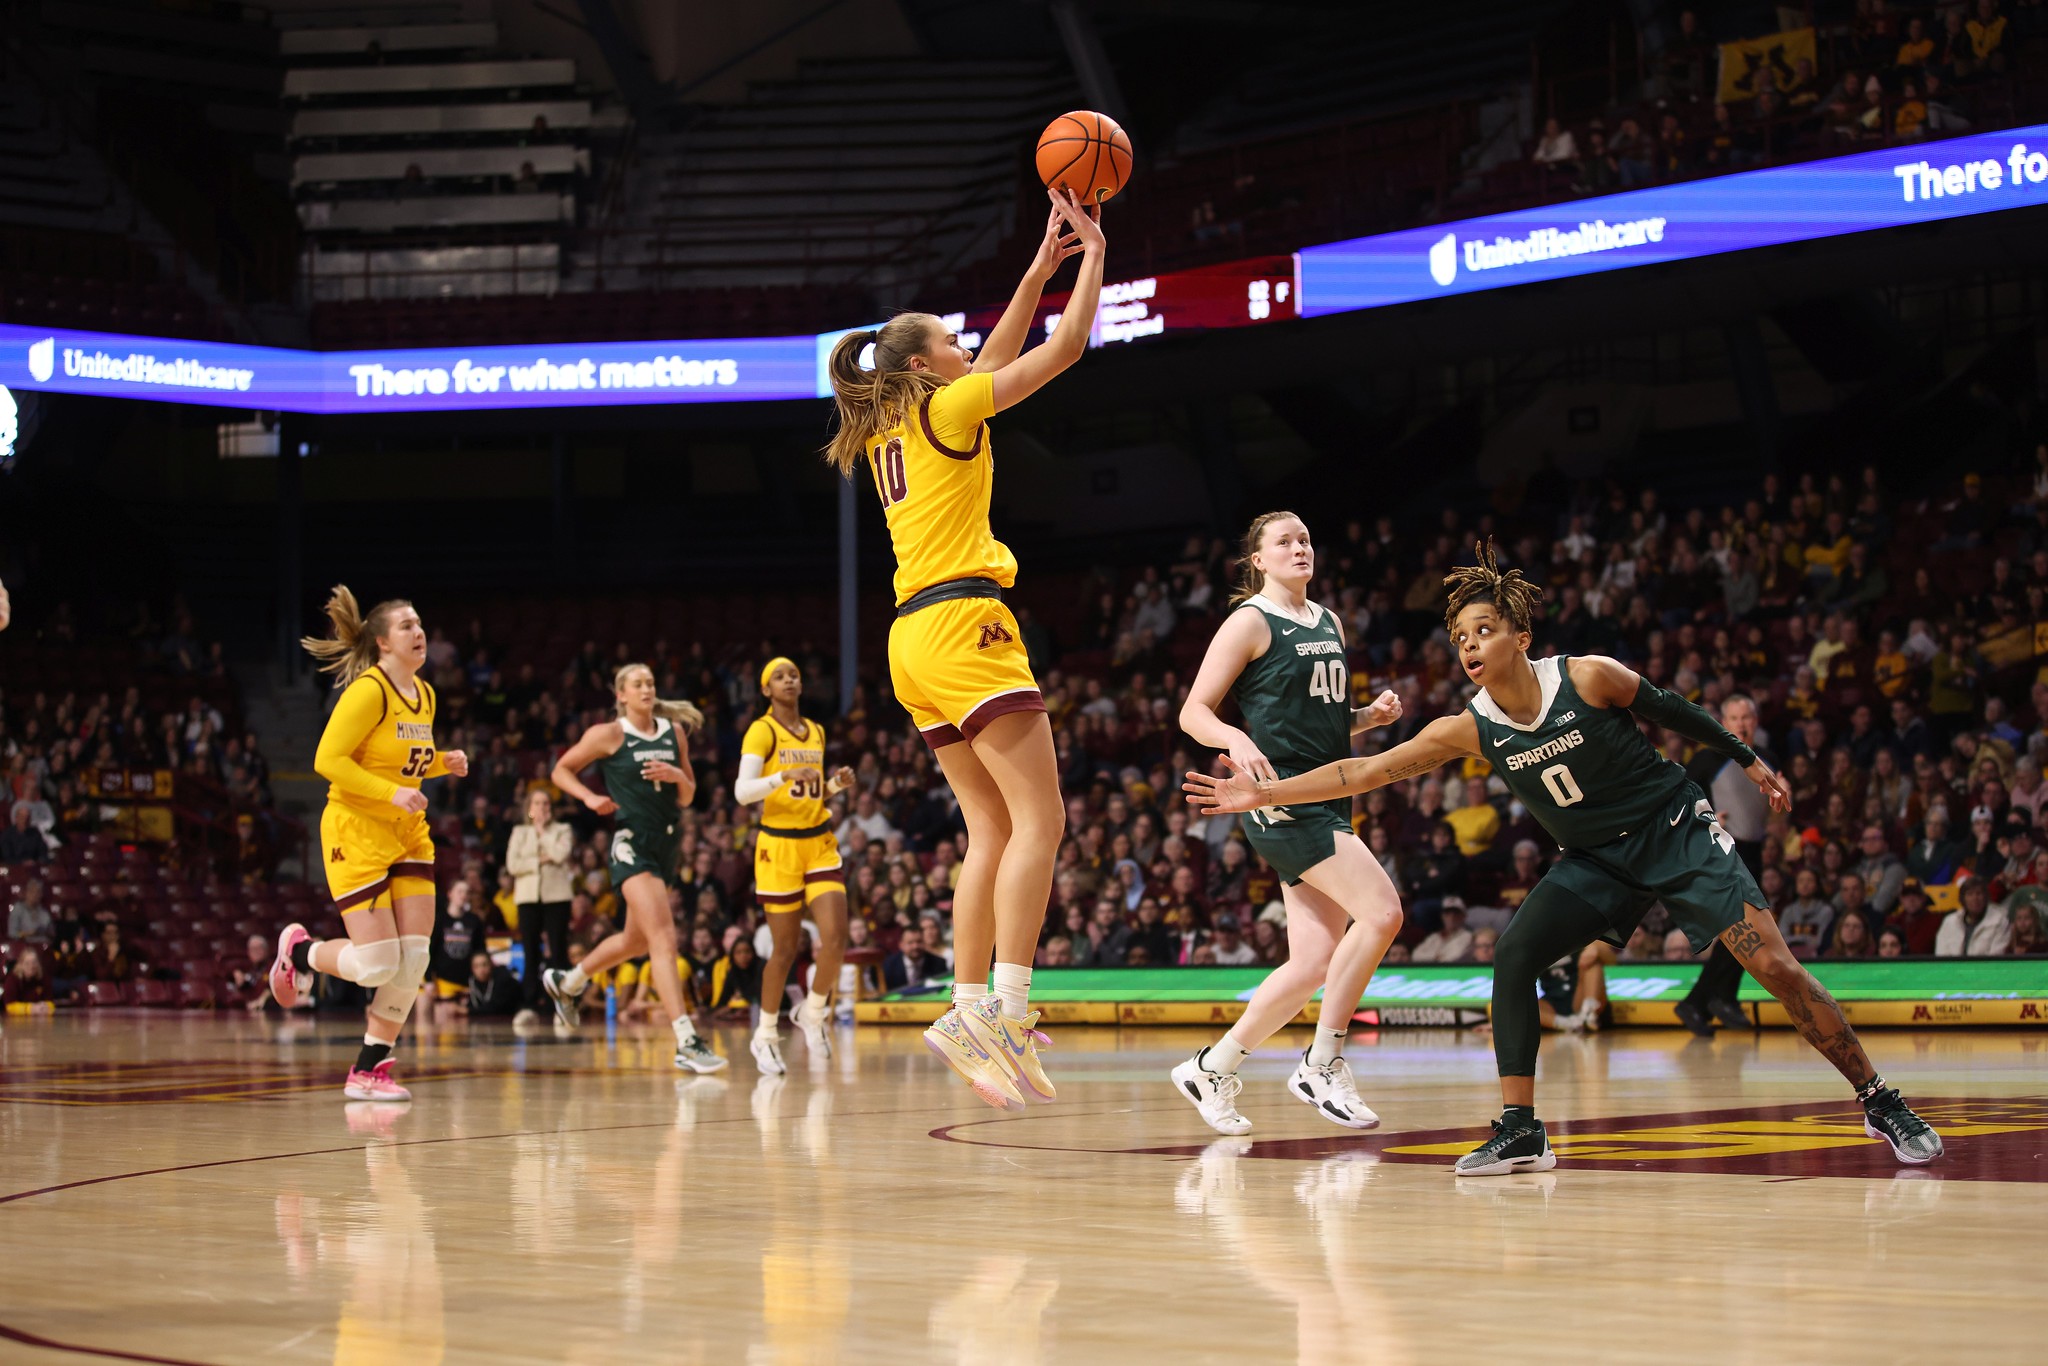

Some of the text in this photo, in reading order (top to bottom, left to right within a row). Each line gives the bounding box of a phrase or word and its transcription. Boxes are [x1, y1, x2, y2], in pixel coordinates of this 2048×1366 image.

[1893, 158, 2003, 202] There
[1463, 217, 1667, 272] UnitedHealthcare
[63, 348, 254, 391] UnitedHealthcare
[348, 355, 739, 397] There for what matters
[873, 436, 909, 510] 10
[976, 619, 1013, 650] M
[1295, 640, 1343, 656] SPARTANS
[1309, 659, 1347, 704] 40
[401, 746, 434, 778] 52
[1505, 729, 1584, 771] SPARTANS
[1540, 763, 1584, 808] 0
[1380, 1007, 1456, 1026] POSSESSION
[1935, 1003, 1973, 1014] HEALTH
